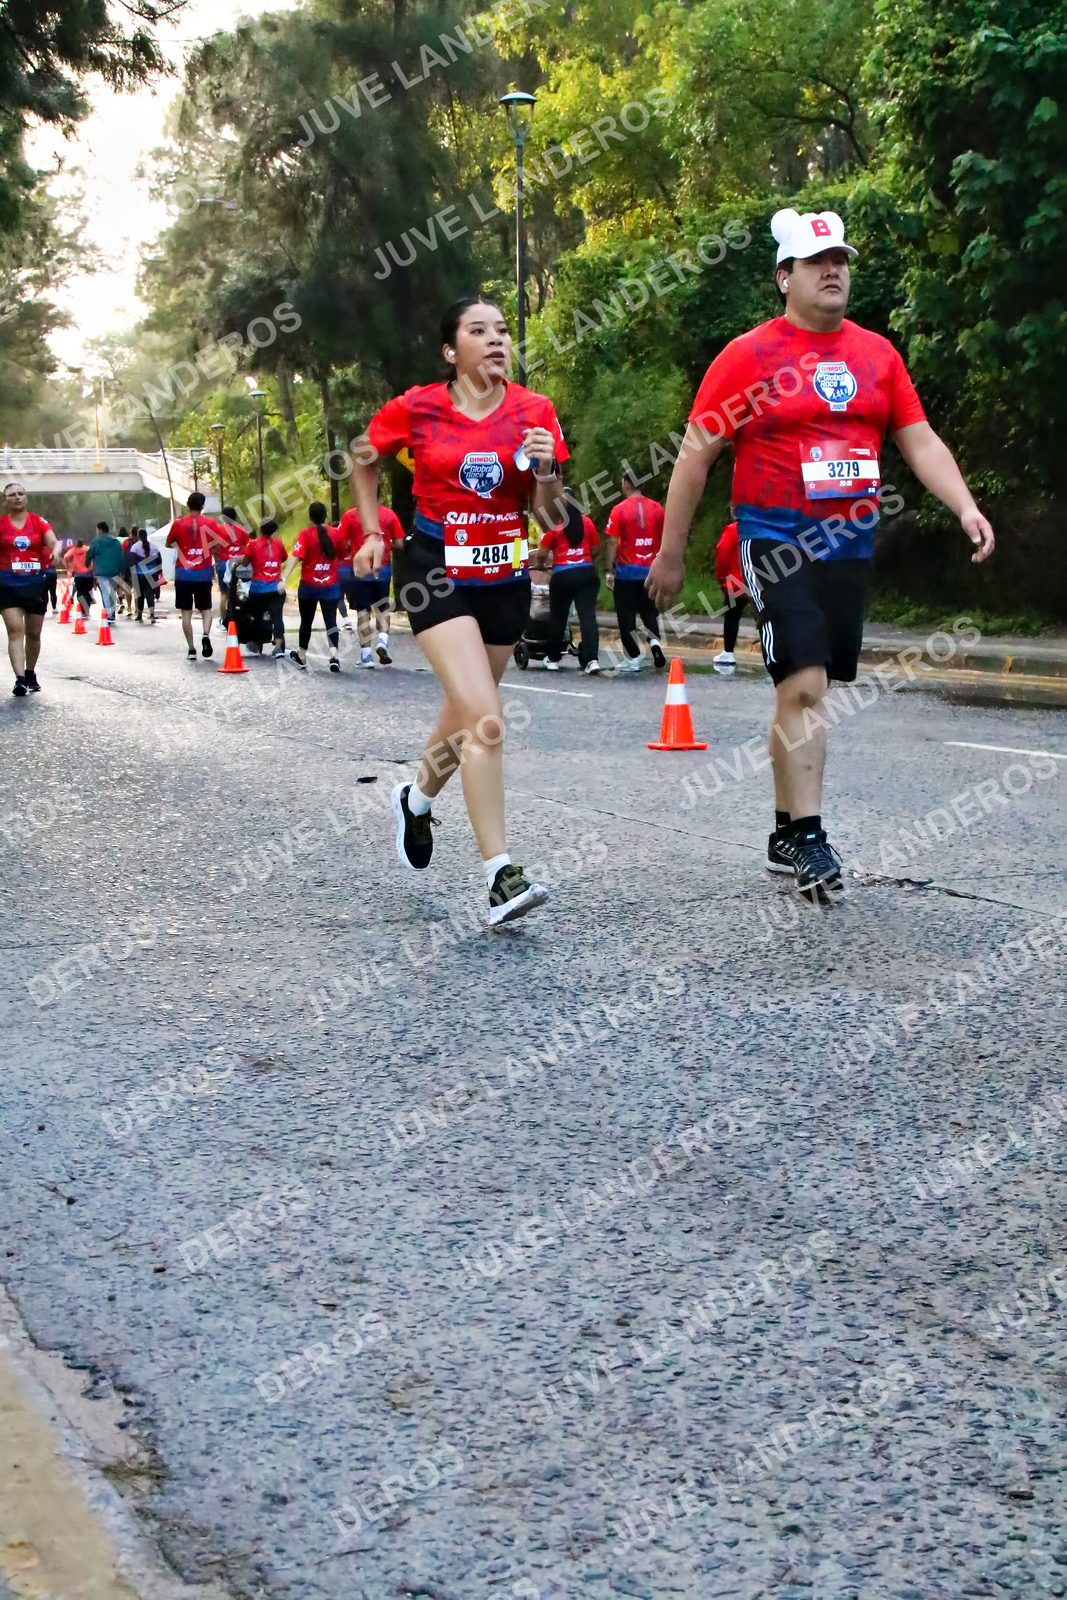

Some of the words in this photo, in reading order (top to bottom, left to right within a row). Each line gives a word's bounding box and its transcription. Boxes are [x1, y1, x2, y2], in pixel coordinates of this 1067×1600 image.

[810, 219, 832, 237] B
[828, 461, 860, 478] 3279
[472, 544, 508, 564] 2484
